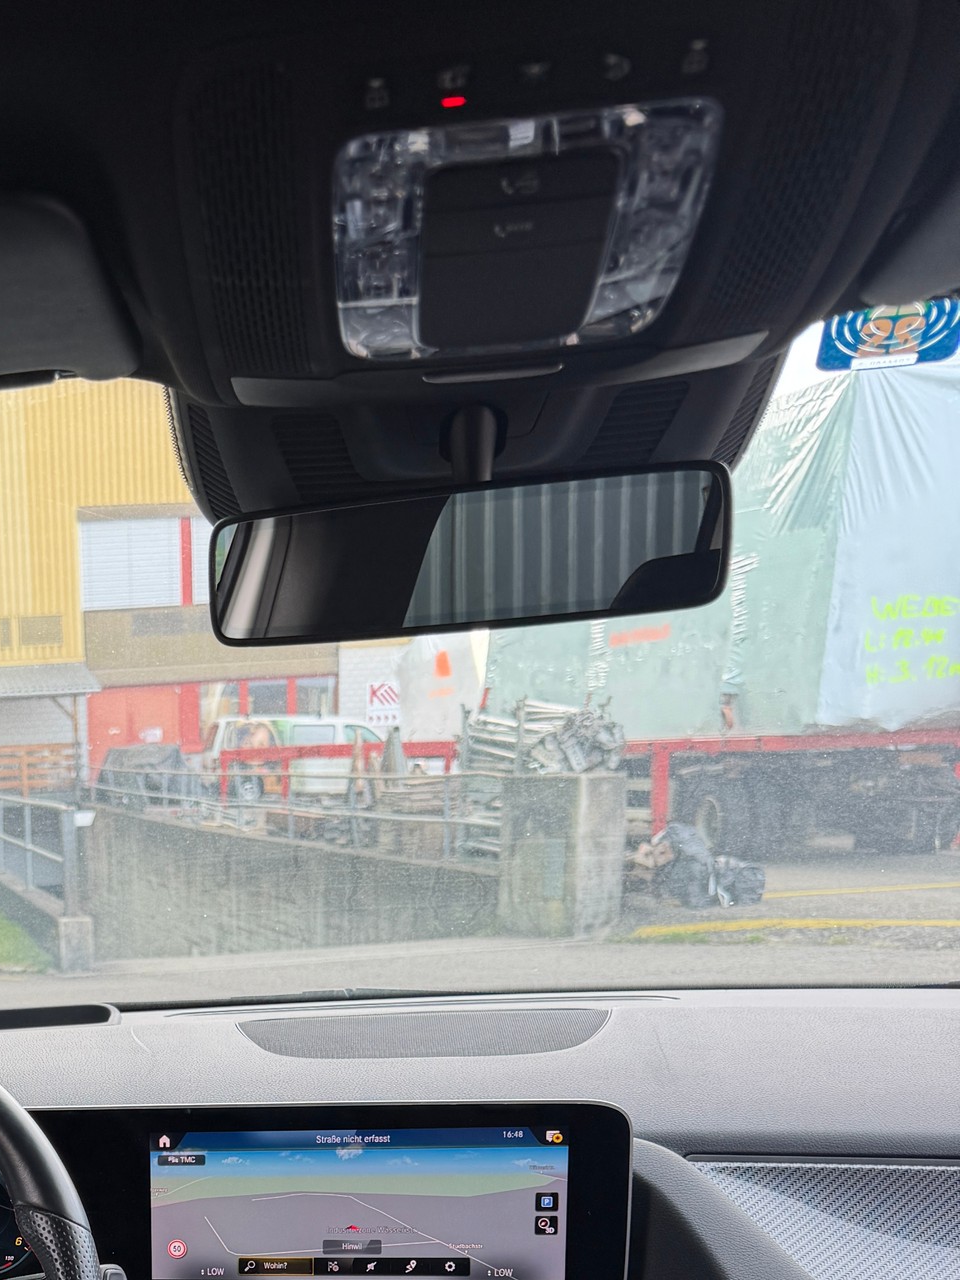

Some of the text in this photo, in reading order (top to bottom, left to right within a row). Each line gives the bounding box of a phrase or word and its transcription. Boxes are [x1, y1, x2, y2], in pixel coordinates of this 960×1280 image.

[502, 1130, 524, 1138] 16:48
[316, 1134, 391, 1144] Straße nicht erfasst
[15, 1237, 23, 1246] 6
[264, 1262, 288, 1270] Wohin?
[207, 1268, 225, 1276] LOW
[494, 1269, 514, 1277] LOW
